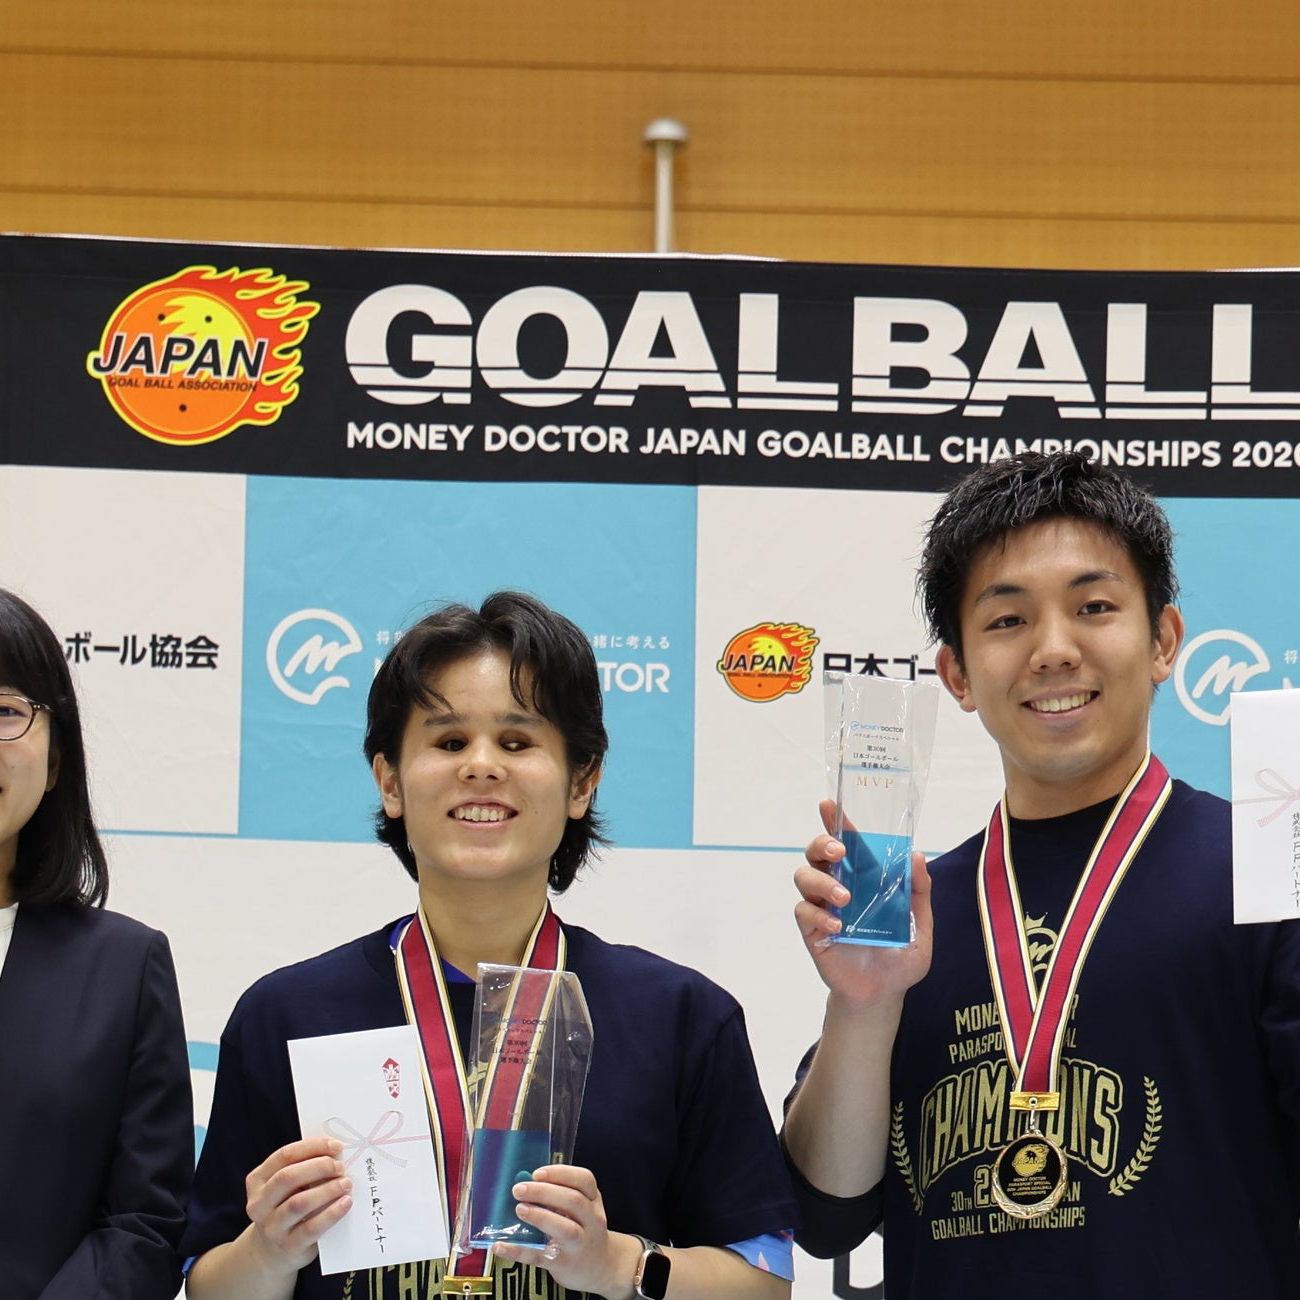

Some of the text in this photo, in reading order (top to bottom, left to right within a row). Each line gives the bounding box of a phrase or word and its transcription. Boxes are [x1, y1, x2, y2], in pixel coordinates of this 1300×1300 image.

[91, 332, 268, 382] JAPAN
[108, 377, 258, 393] GOAL BALL ASSOCIATION
[346, 422, 473, 451] MONEY
[484, 425, 629, 454] DOCTOR
[640, 428, 746, 456] JAPAN
[757, 430, 931, 462] GOALBALL
[55, 631, 220, 671] ボール協会
[720, 653, 796, 673] JAPAN
[599, 661, 672, 694] TOR
[954, 1000, 1001, 1036] MONE
[948, 1030, 1007, 1065] PARASPO
[931, 1214, 985, 1241] GOALBALL
